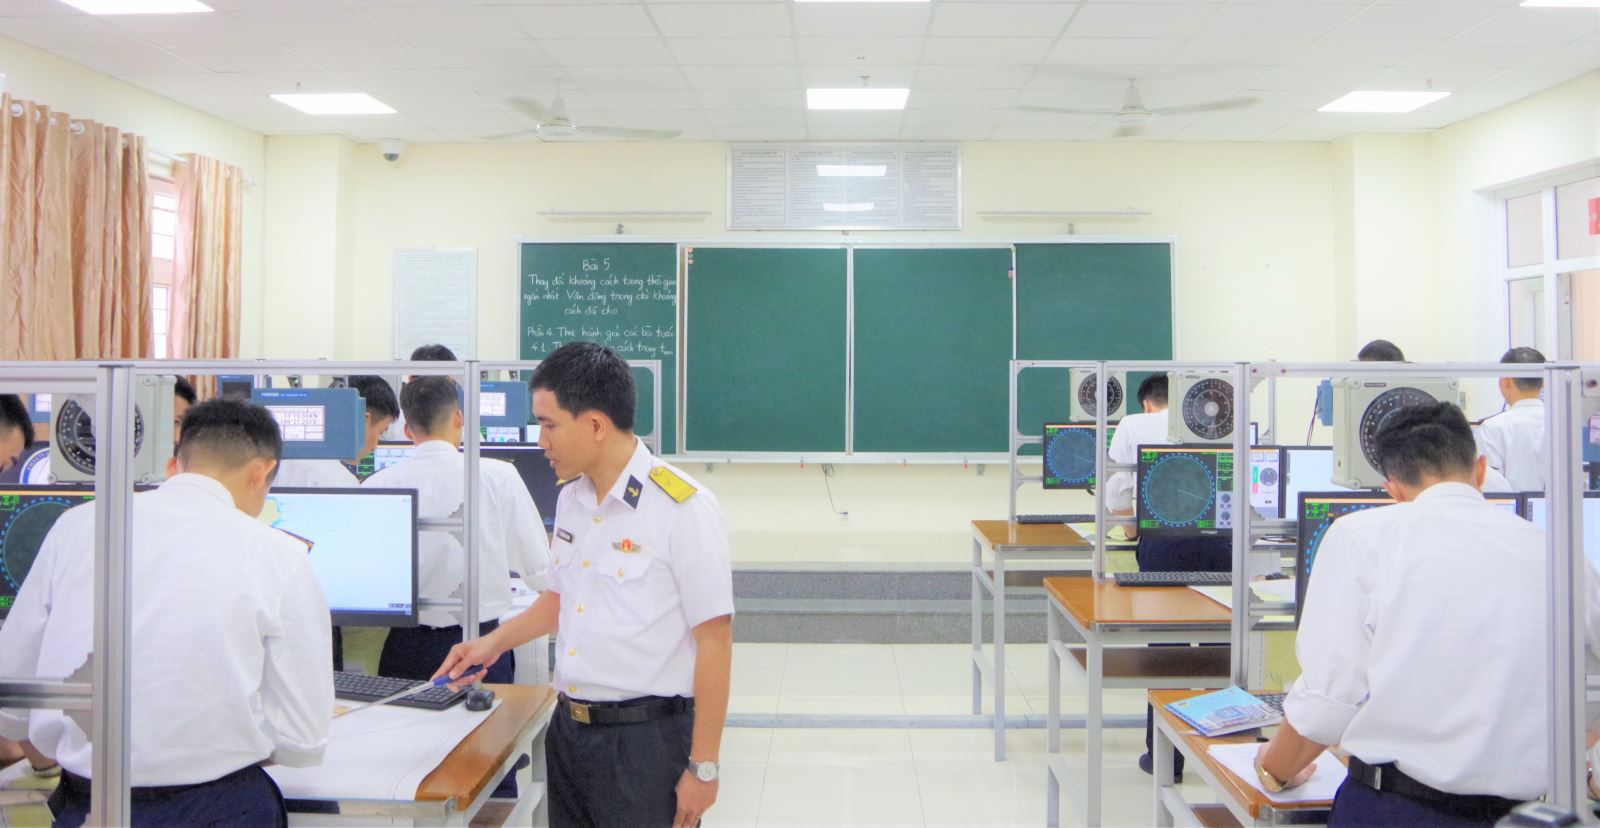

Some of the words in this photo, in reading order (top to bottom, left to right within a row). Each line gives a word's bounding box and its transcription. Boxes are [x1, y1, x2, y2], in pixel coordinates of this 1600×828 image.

[582, 258, 598, 271] Bài
[604, 258, 610, 270] 5
[528, 274, 548, 290] Thay
